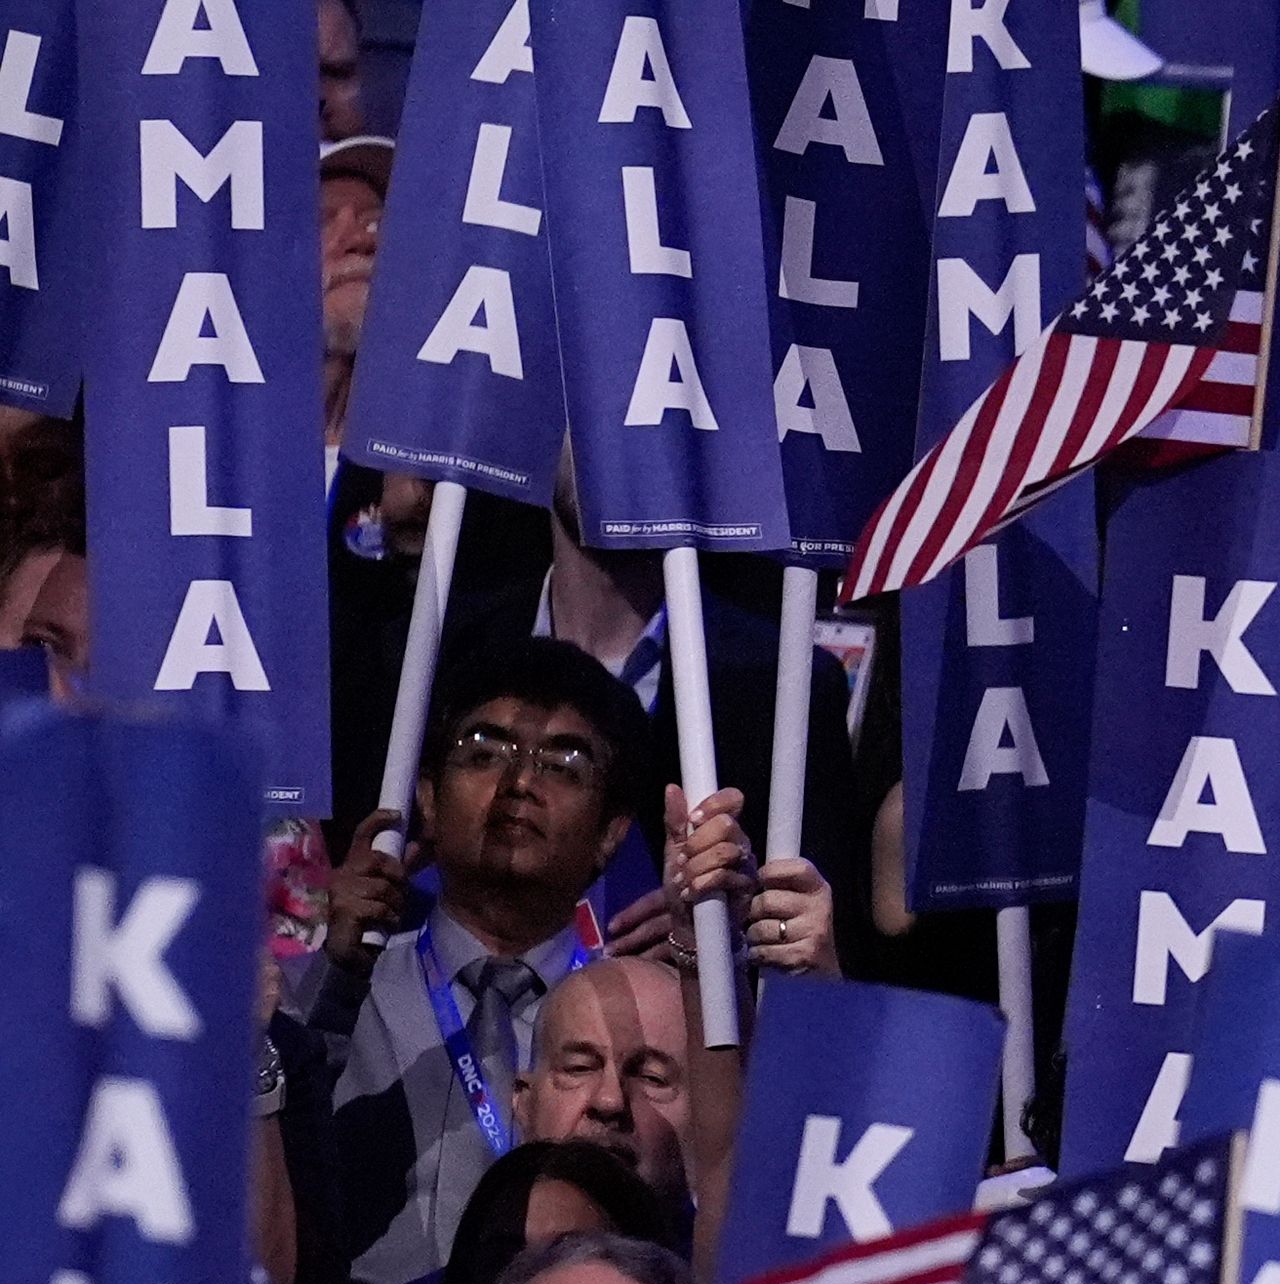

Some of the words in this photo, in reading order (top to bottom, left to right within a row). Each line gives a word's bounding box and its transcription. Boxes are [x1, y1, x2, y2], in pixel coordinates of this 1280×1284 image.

[597, 15, 720, 431] ALA
[373, 443, 397, 455] PAID
[418, 454, 454, 466] HARRIS
[456, 459, 476, 470] FOR
[477, 463, 527, 485] PRESIDENT
[606, 524, 631, 533] PAID
[652, 523, 692, 532] HARRIS
[457, 1053, 483, 1094] DNC
